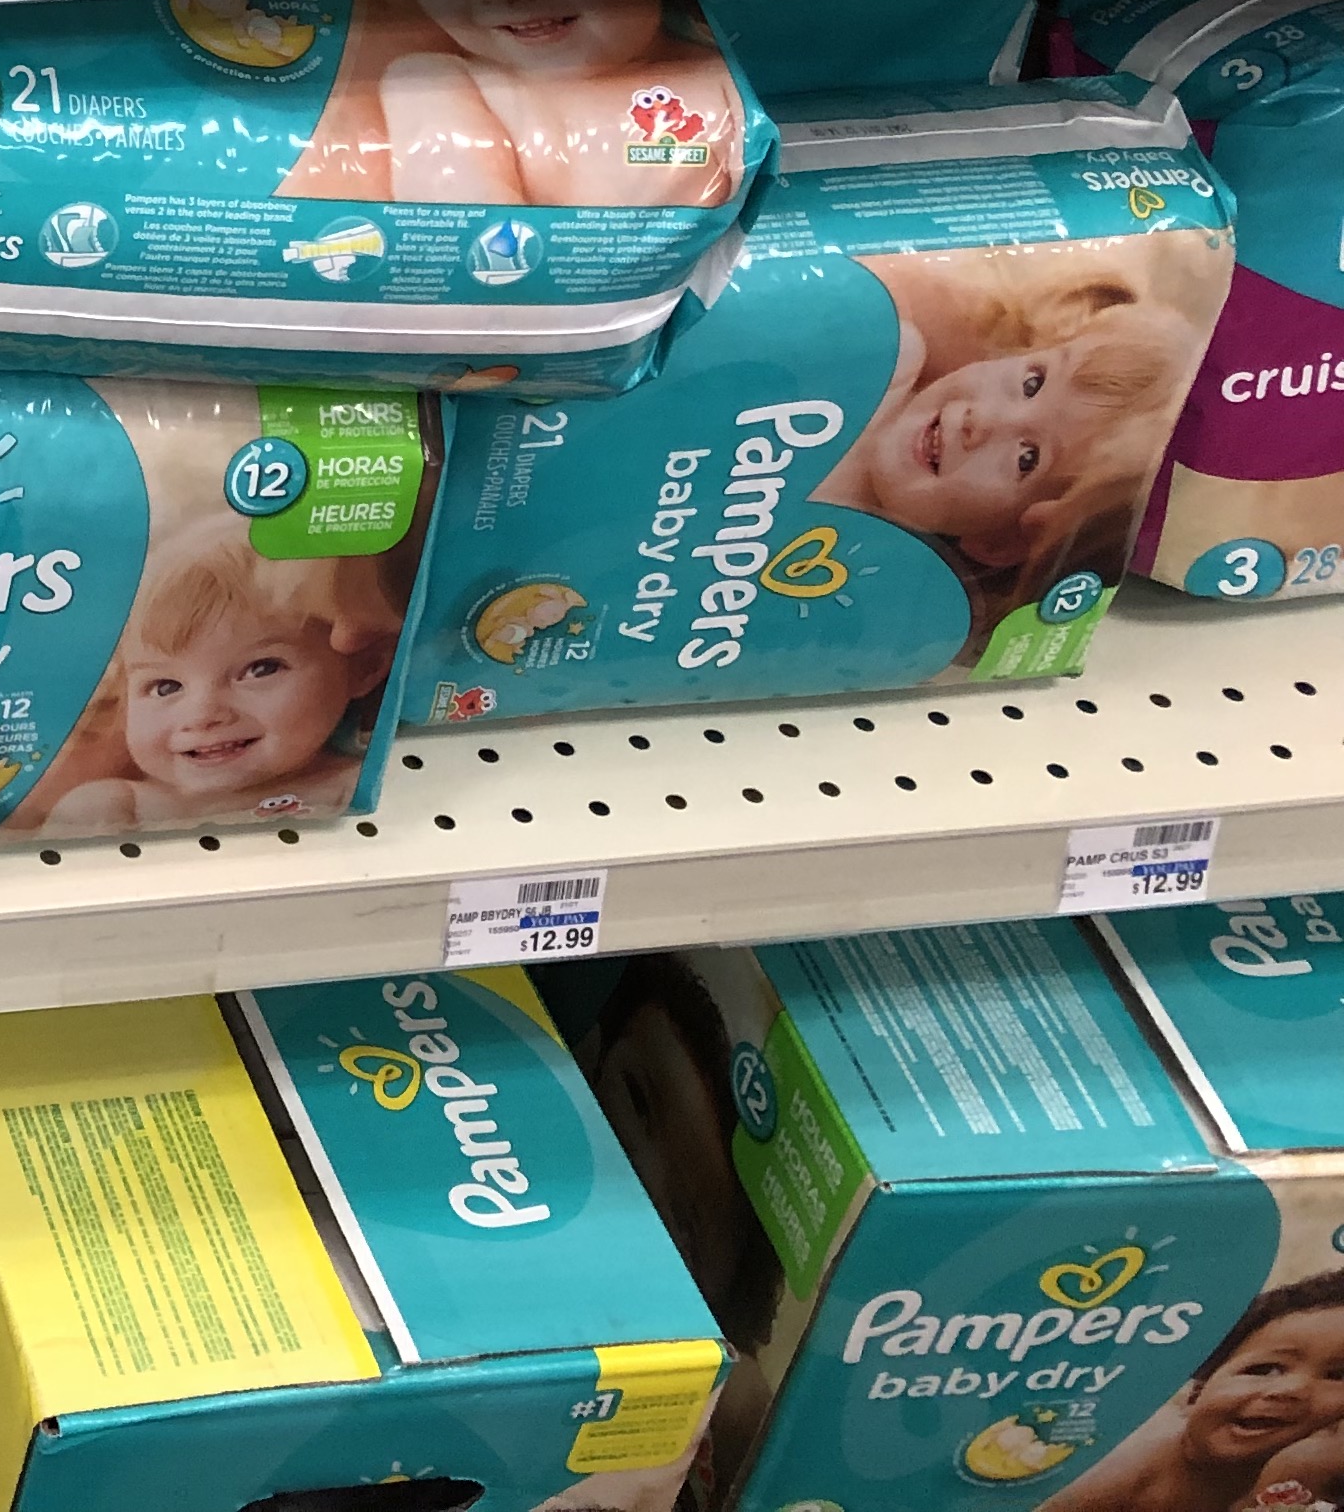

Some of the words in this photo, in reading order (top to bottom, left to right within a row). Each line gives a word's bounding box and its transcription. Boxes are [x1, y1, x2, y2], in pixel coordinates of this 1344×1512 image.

[8, 63, 61, 115] 21
[68, 94, 148, 120] DIAPERS
[125, 194, 167, 205] Pampers
[170, 195, 185, 205] has
[188, 197, 194, 206] 3
[197, 198, 225, 209] layers
[228, 199, 239, 208] of
[241, 200, 297, 213] absorbency
[244, 462, 289, 498] 12
[318, 456, 403, 477] HORAS
[310, 502, 396, 524] HEURES
[637, 448, 712, 560] baby
[677, 399, 844, 670] Pampers
[1217, 547, 1259, 596] 3
[1290, 544, 1342, 586] 28
[618, 576, 678, 643] dry
[1066, 854, 1107, 866] PAMP
[1110, 850, 1148, 863] CRUS
[1133, 870, 1204, 895] $12.99
[450, 911, 478, 924] PAMP
[520, 927, 594, 952] $12.99
[380, 979, 552, 1231] Pampers
[841, 1288, 1206, 1366] Pampers
[867, 1368, 1020, 1401] baby
[1025, 1360, 1128, 1393] dry
[570, 1393, 615, 1421] #1
